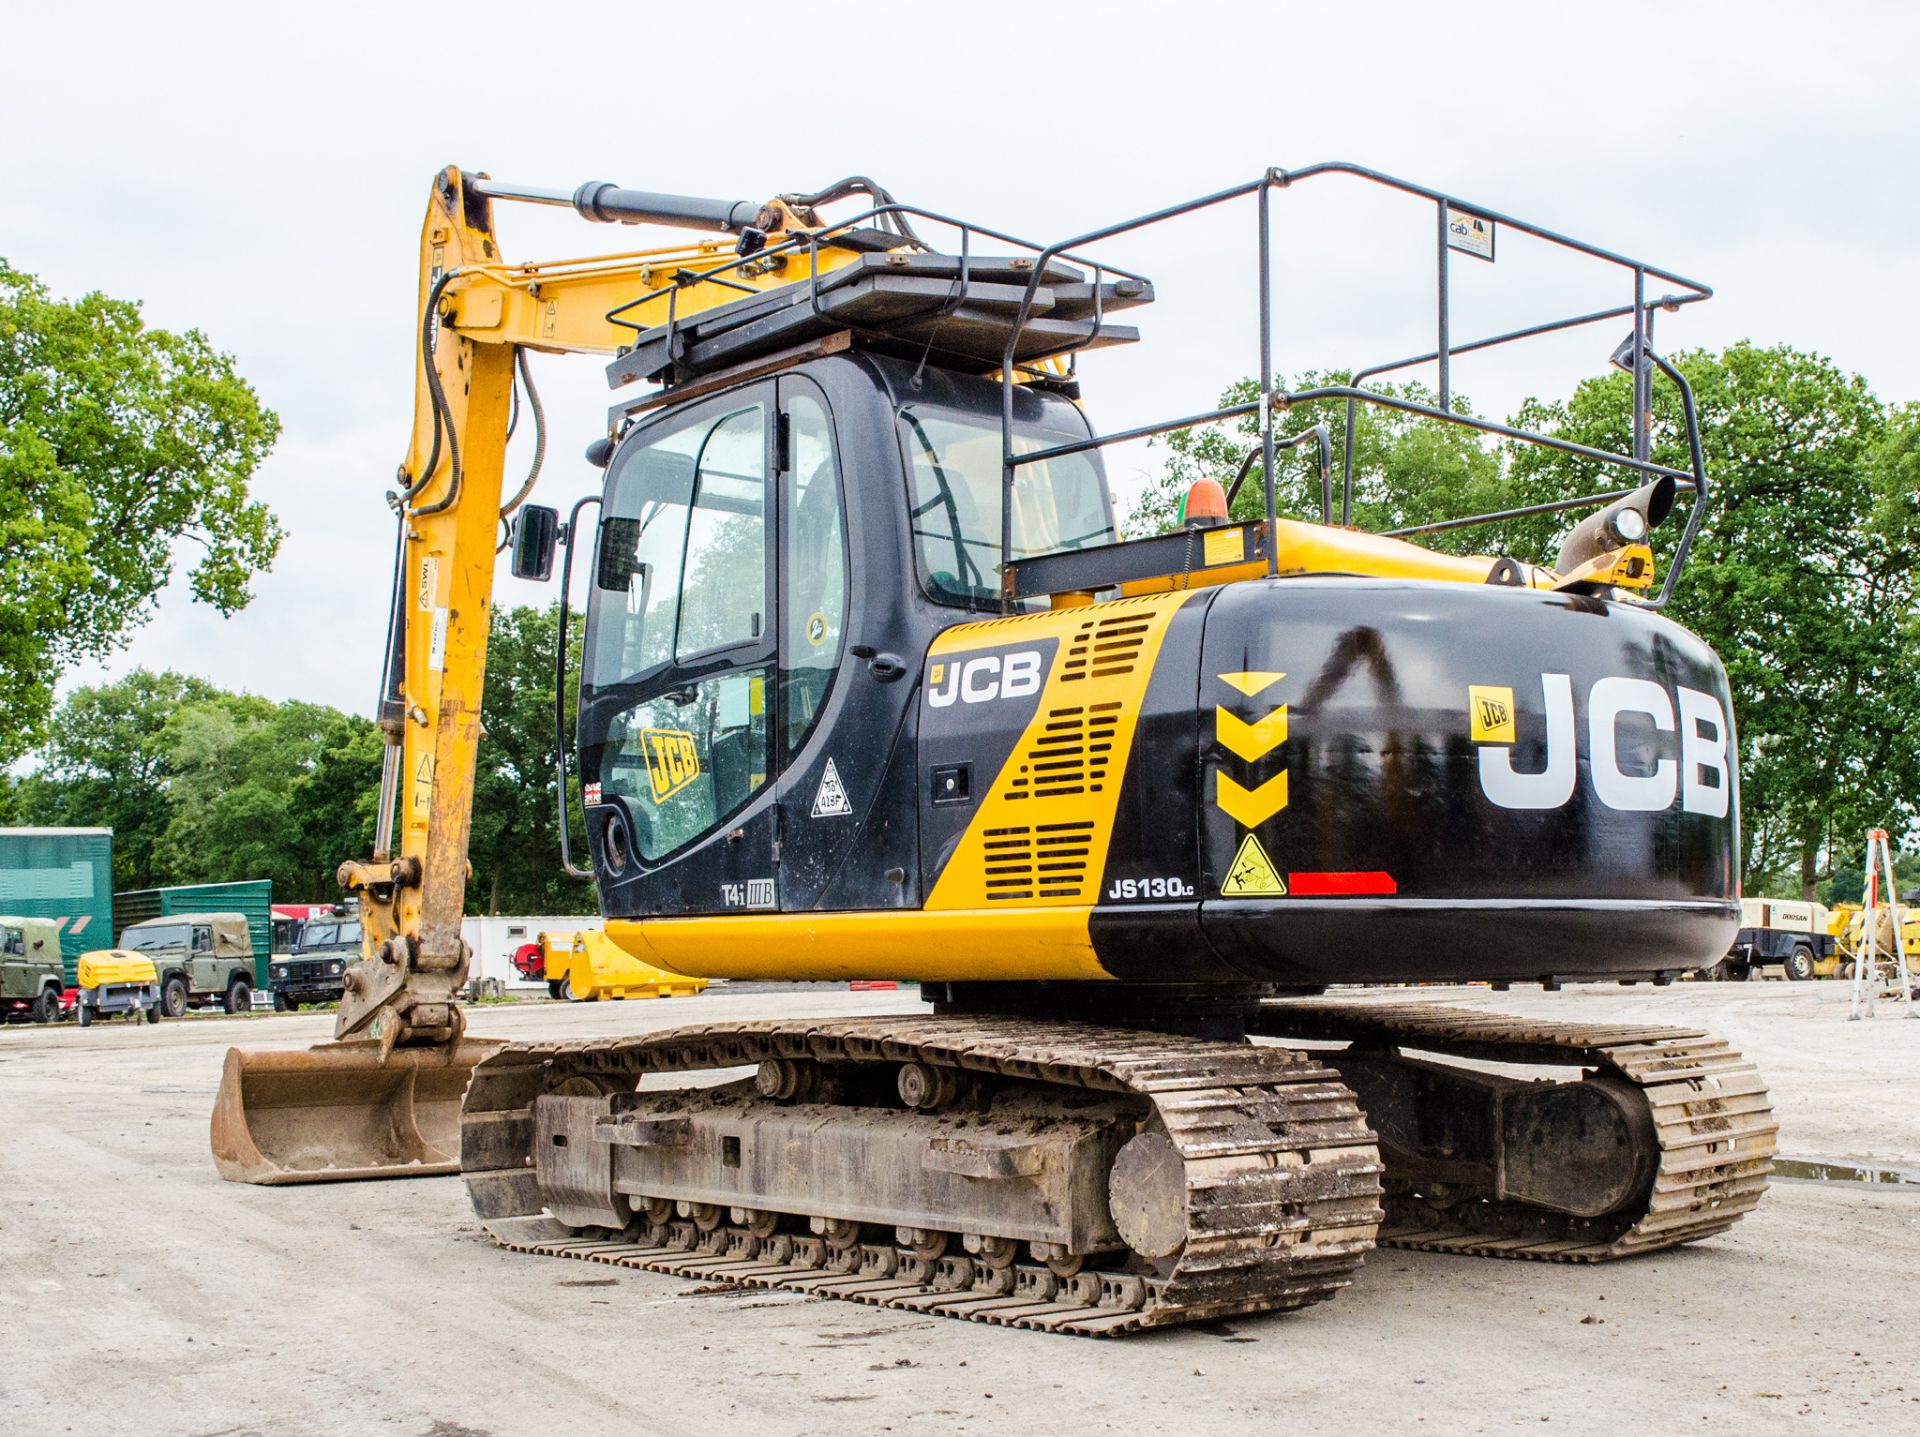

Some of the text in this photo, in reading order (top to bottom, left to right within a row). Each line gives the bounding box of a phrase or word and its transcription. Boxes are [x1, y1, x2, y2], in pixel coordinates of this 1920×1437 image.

[928, 651, 1042, 708] JCB
[1482, 701, 1508, 728] JCB
[650, 735, 696, 795] JCB
[1479, 672, 1729, 819] JCB
